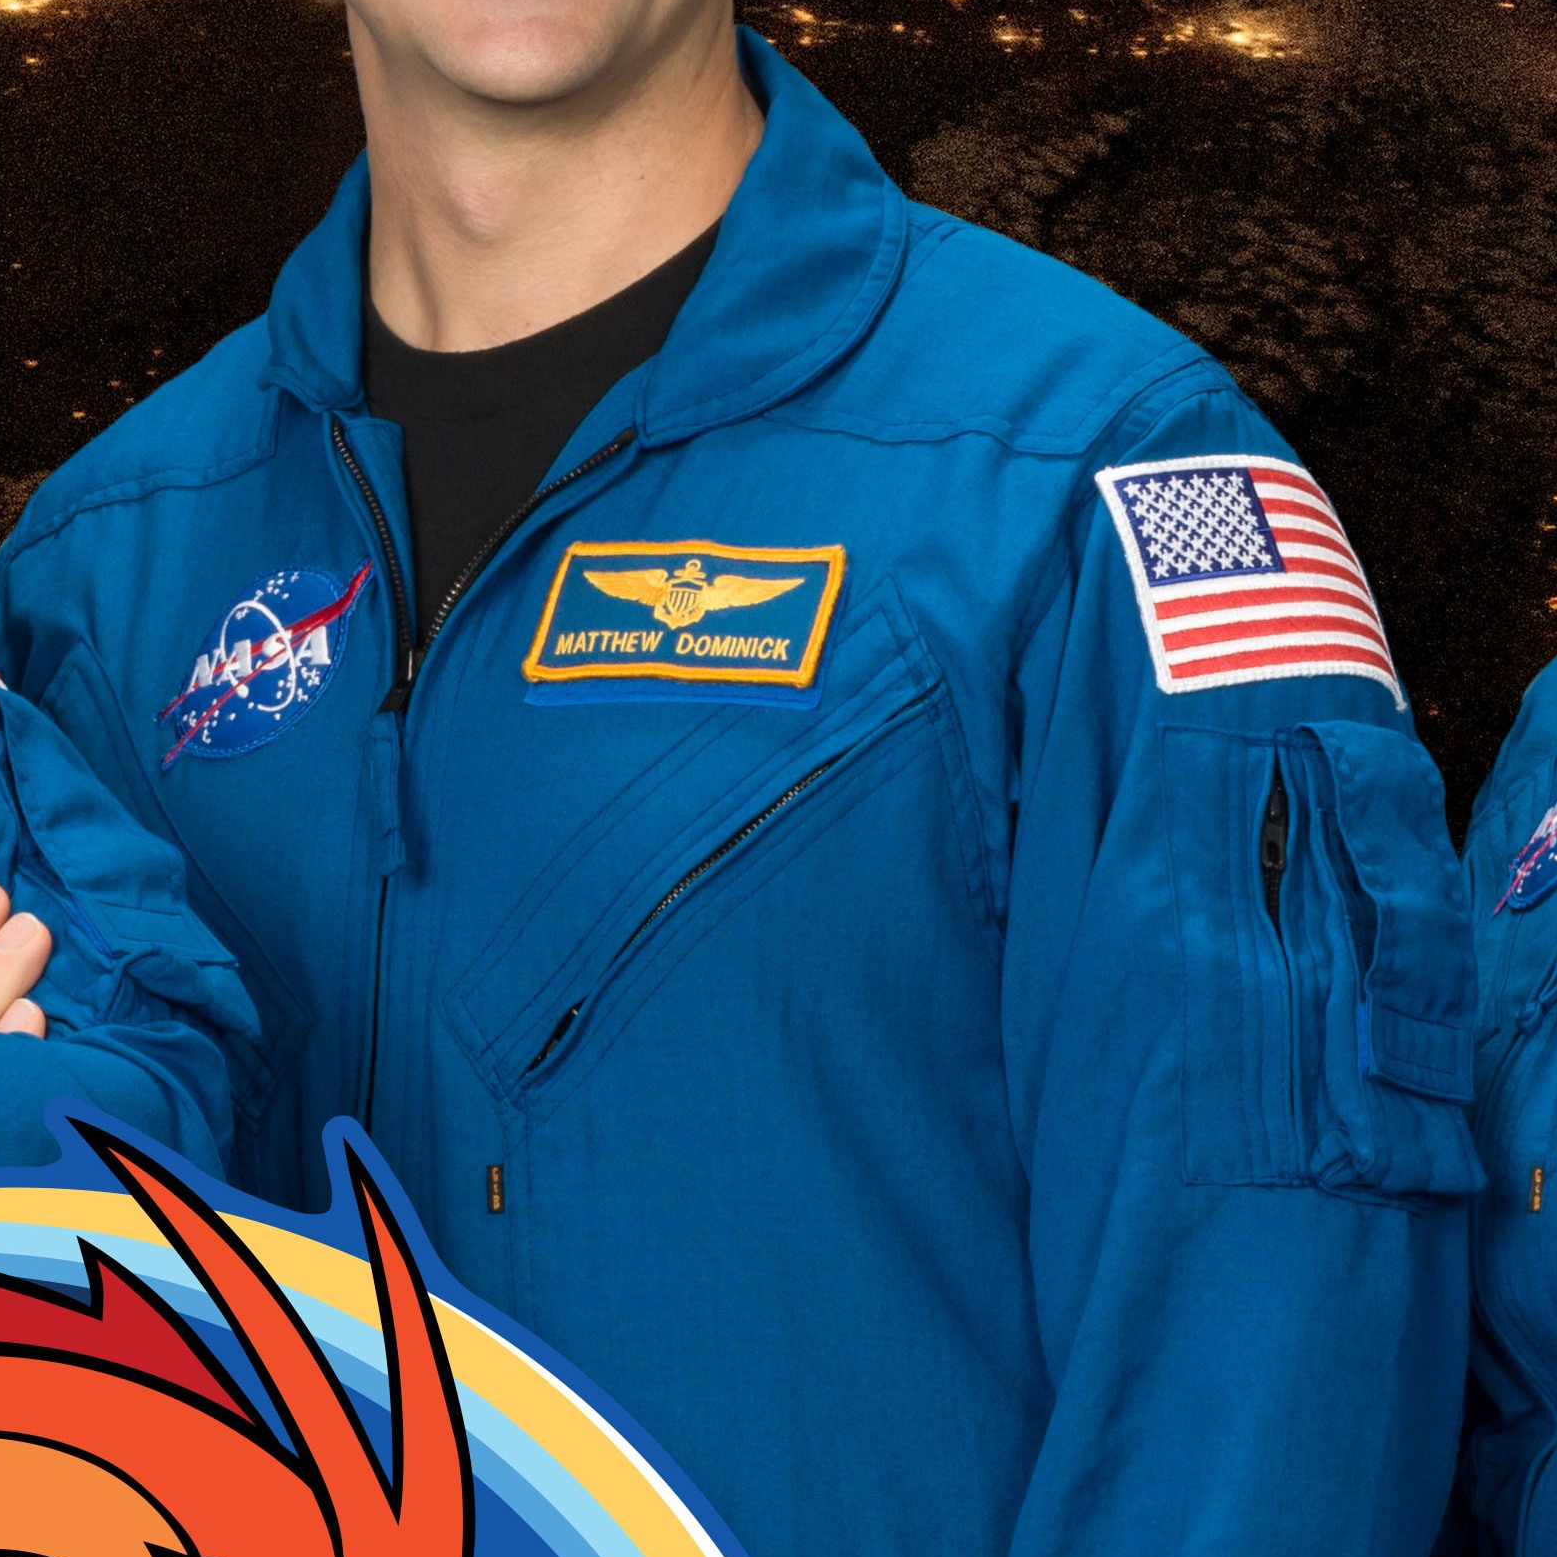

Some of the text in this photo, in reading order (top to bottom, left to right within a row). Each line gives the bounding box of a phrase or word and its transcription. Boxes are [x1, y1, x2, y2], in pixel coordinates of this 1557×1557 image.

[187, 624, 332, 693] NASA
[554, 630, 790, 661] MATTHEW DOMINICK
